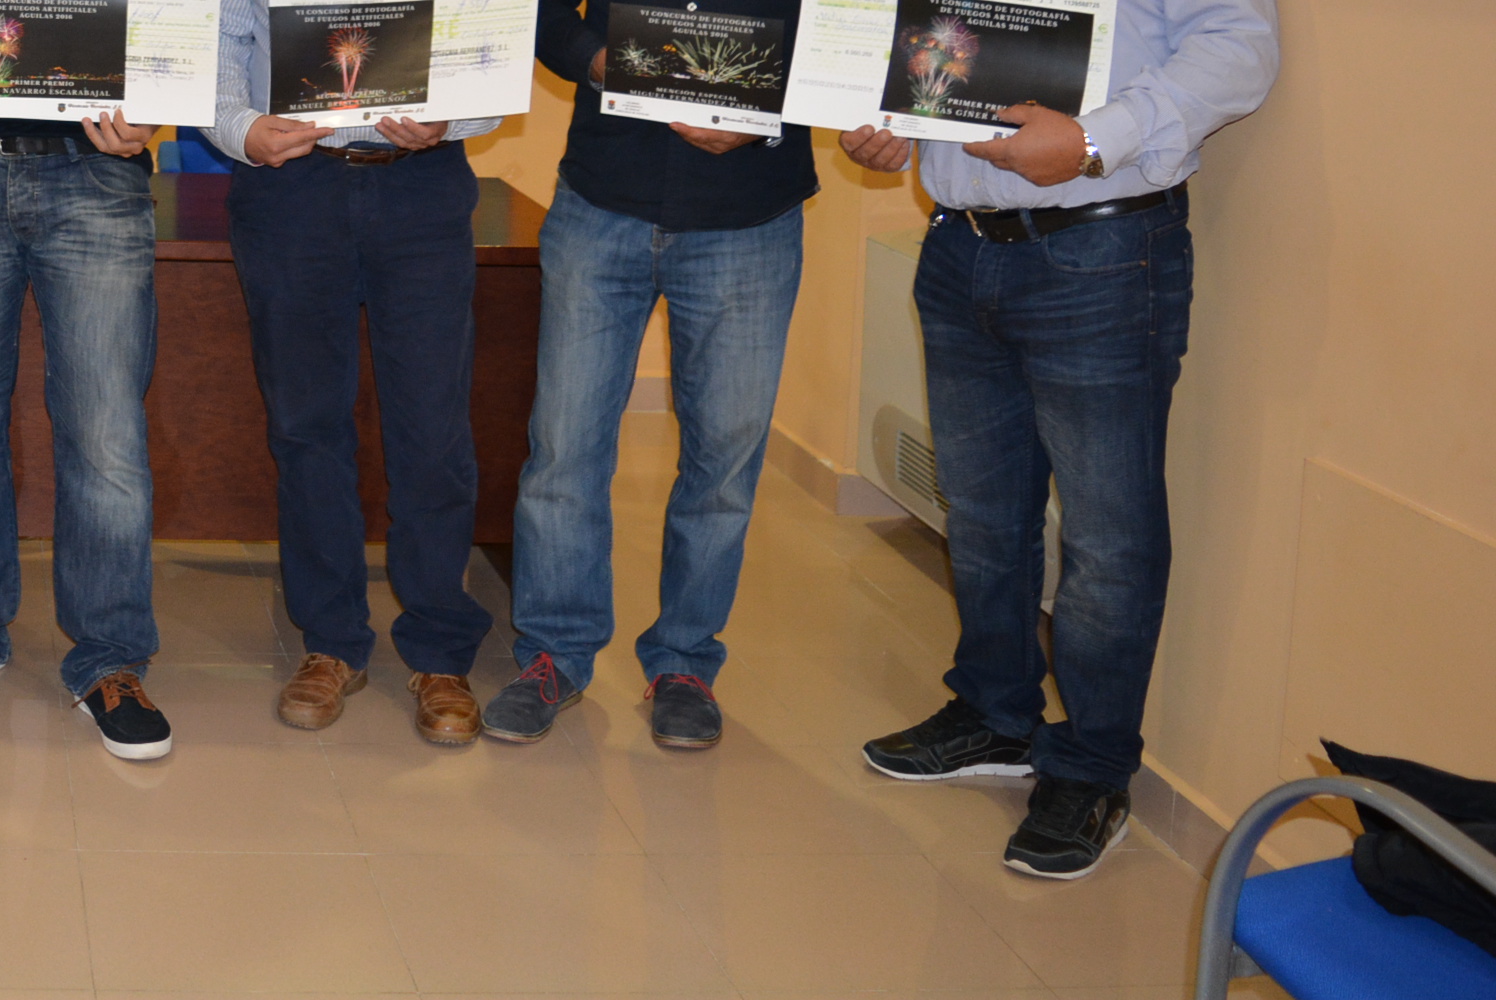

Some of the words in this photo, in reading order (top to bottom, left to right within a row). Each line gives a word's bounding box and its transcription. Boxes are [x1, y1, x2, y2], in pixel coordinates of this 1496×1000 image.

[42, 5, 97, 13] ARTIFICIALES
[57, 0, 108, 7] FOTOGRAFÍA
[365, 4, 415, 13] FOTOGRAFÍA
[19, 11, 54, 19] ÁGUILAS
[317, 15, 348, 23] FUEGOS
[350, 12, 405, 22] ARTIFICIALES
[940, 6, 953, 14] DE
[955, 8, 991, 18] FUEGOS
[993, 13, 1058, 27] ARTIFICIALES
[995, 5, 1008, 13] DE
[1010, 7, 1070, 21] FOTOGRAFÍA
[651, 10, 697, 21] CONCURSO
[699, 15, 710, 23] DE
[712, 17, 766, 28] FOTOGRAFÍA
[966, 16, 1006, 29] ÁGUILAS
[1008, 24, 1029, 32] 2016
[328, 22, 362, 30] ÁGUILAS
[662, 18, 695, 27] FUEGOS
[696, 22, 755, 34] ARTIFICIALES
[672, 26, 709, 36] ÁGUILAS
[710, 31, 729, 39] 2016
[4, 87, 46, 95] NAVARRO
[49, 88, 112, 98] ESCARABAJAL
[698, 92, 738, 102] ESPECIAL
[289, 102, 325, 111] MANUEL
[374, 95, 407, 104] MUÑOZ
[629, 89, 667, 100] MIGUEL
[729, 102, 760, 111] PARRA
[947, 97, 983, 109] PRIMER
[955, 109, 989, 120] GINER
